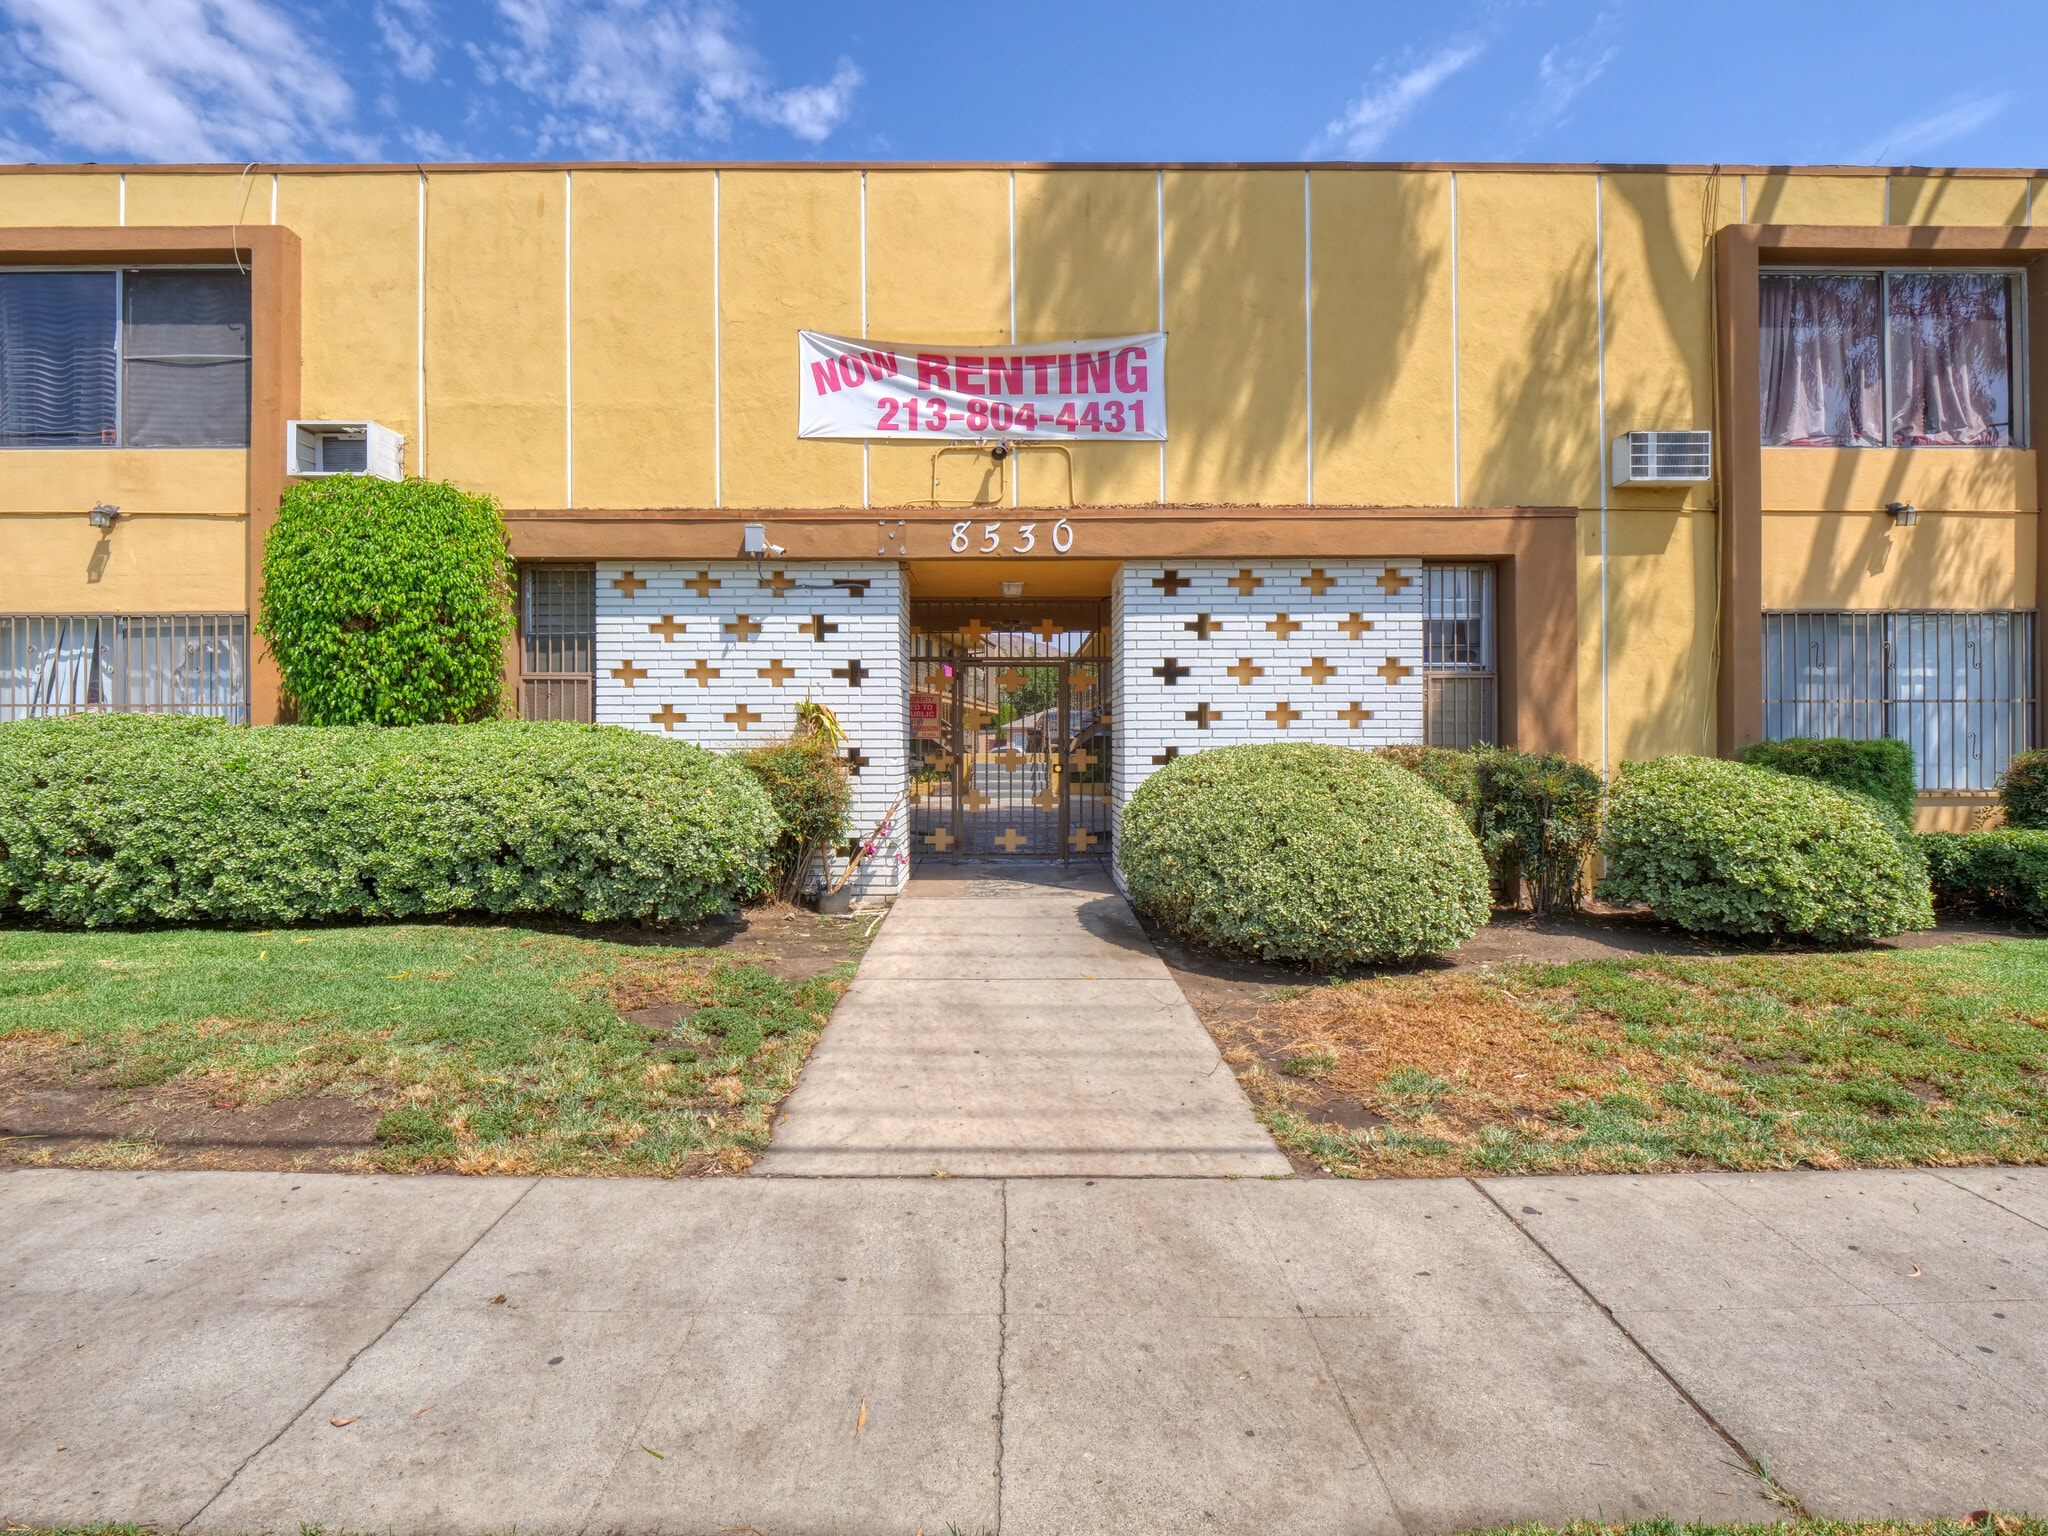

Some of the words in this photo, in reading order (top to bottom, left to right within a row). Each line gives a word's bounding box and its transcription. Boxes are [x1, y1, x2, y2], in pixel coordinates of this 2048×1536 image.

[811, 351, 898, 396] NOW
[917, 346, 1148, 395] RENTING
[877, 397, 1145, 433] 213-804-4431
